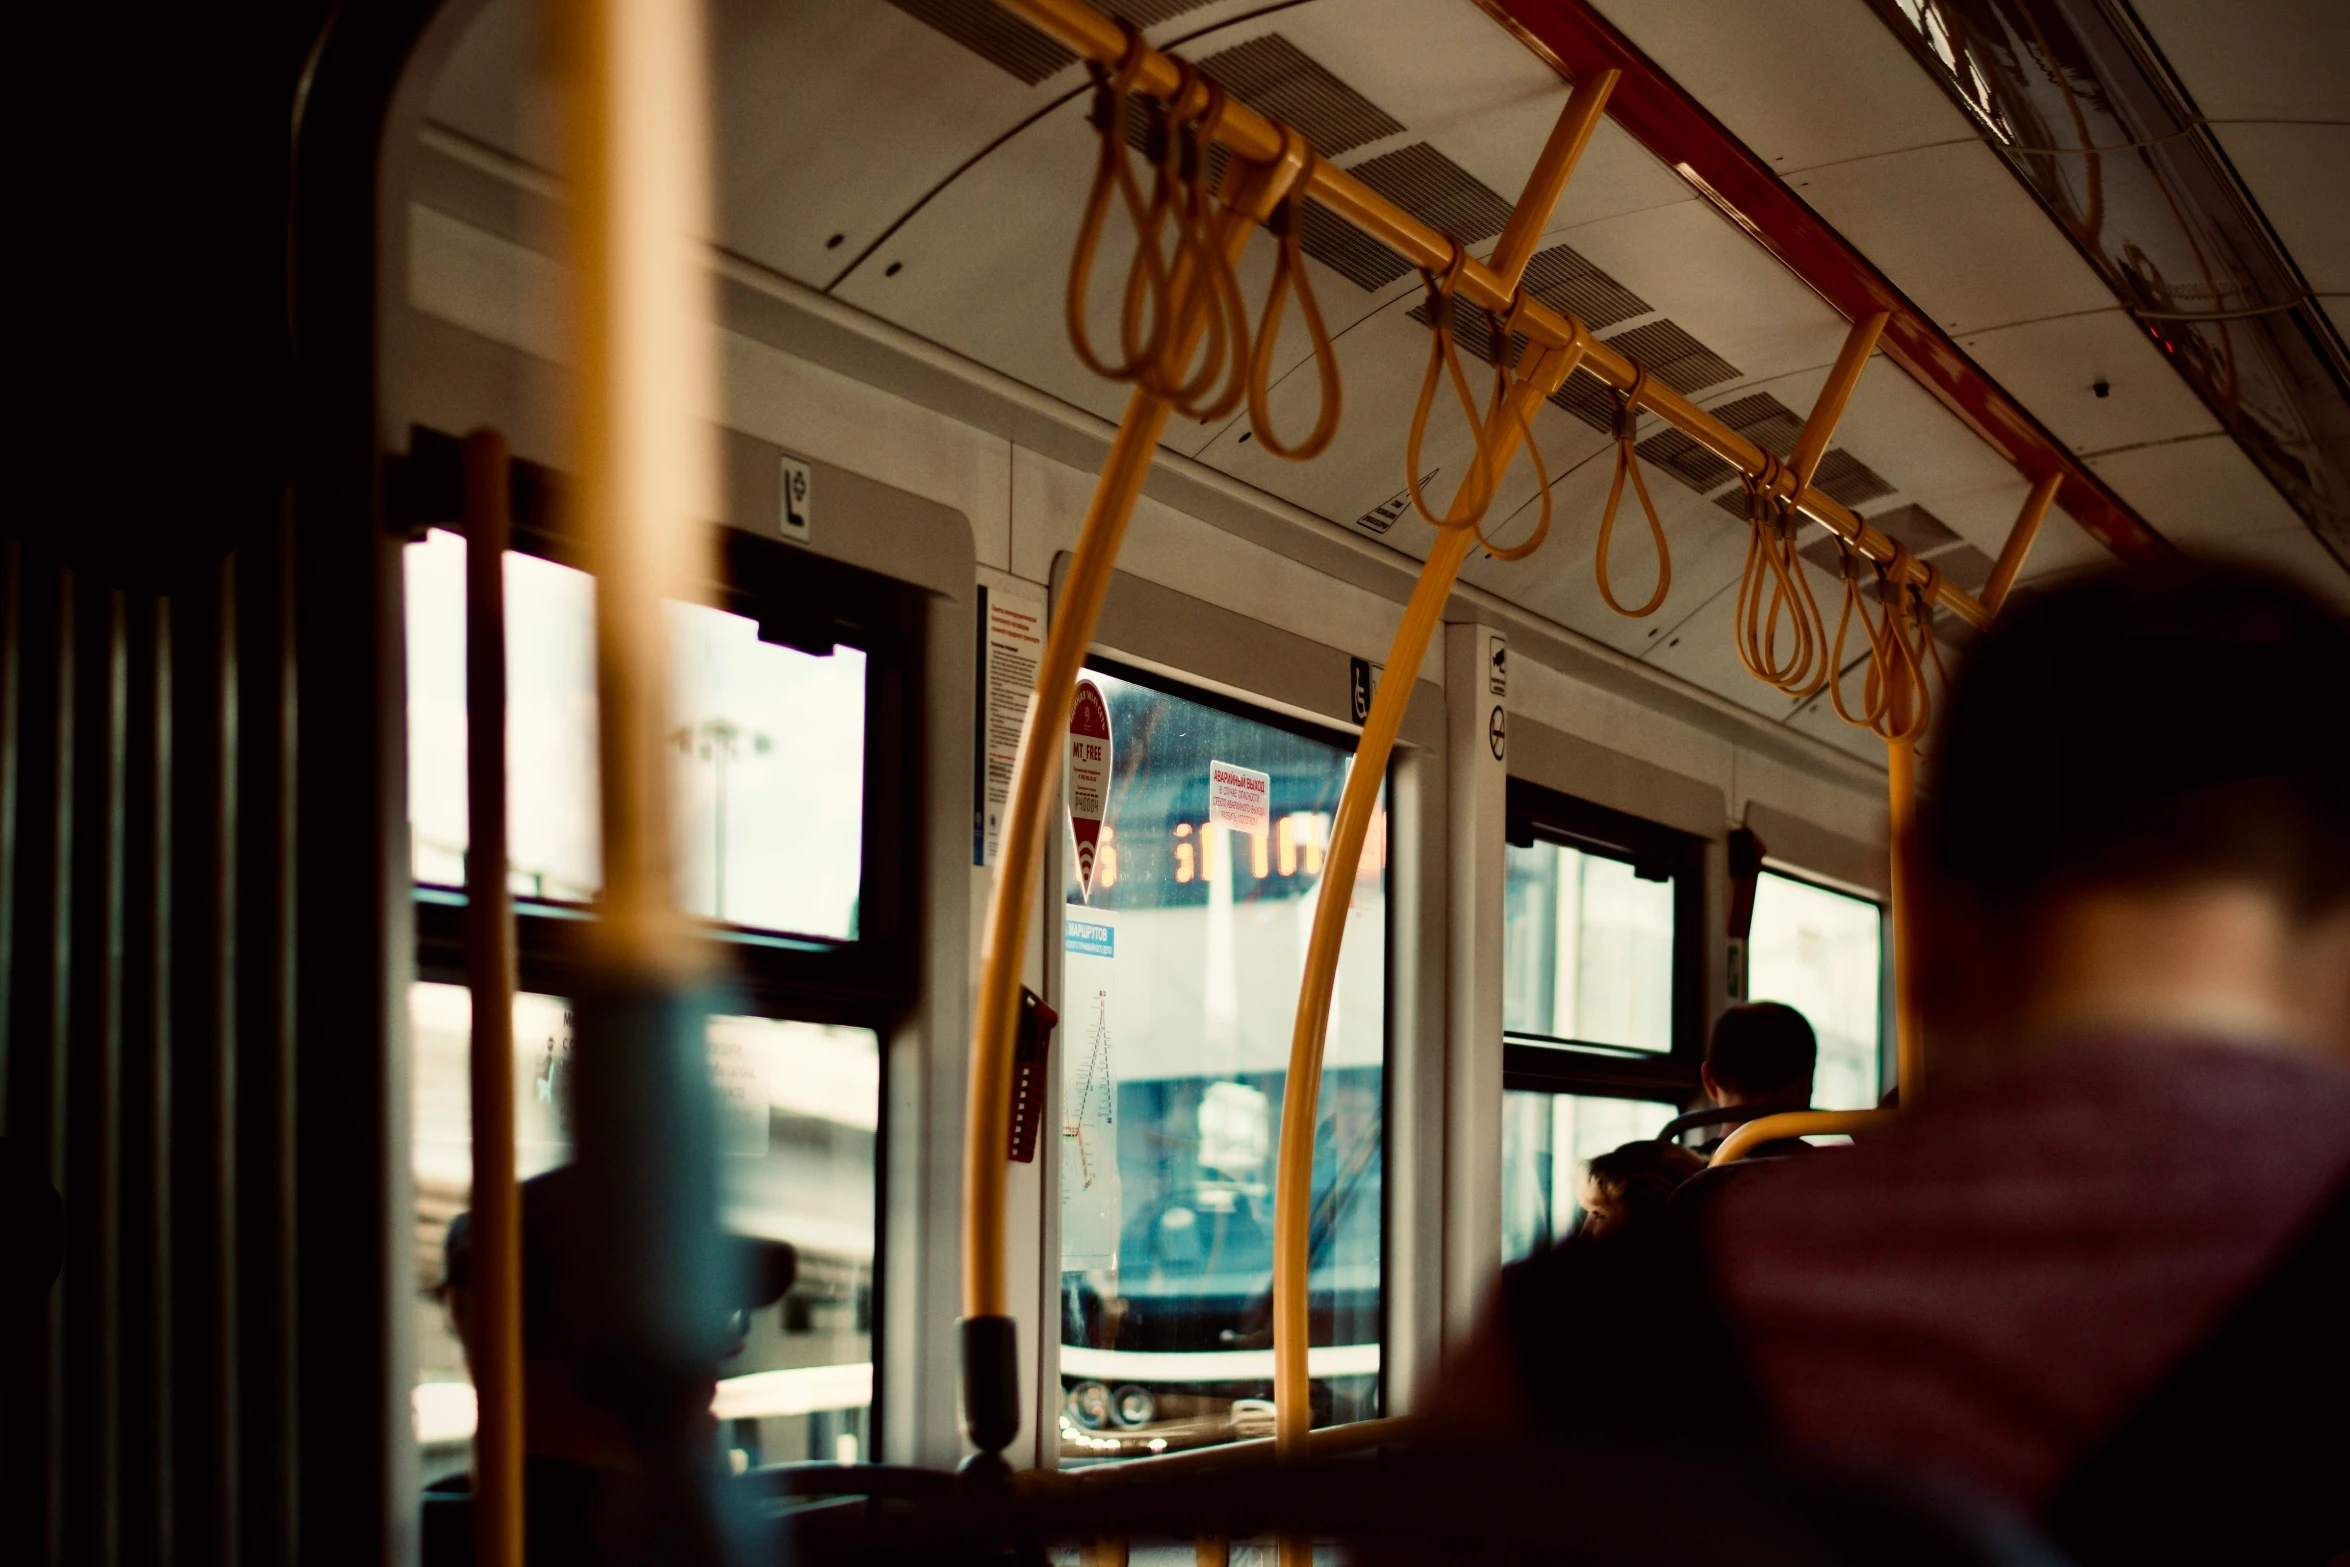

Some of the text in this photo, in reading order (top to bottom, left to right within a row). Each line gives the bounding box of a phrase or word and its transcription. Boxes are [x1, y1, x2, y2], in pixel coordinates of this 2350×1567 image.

[1072, 742, 1102, 763] MT_FREE
[1214, 770, 1265, 793] АВАРИЙНЫЙ ВЫХОД
[1219, 785, 1260, 802] В СЛУЧАЕ ОПАСНОСТИ
[1213, 796, 1265, 816] СТЕКЛО АВАРИЙНОГО ВЫХОДА
[1068, 922, 1108, 942] МАРШРУТОВ
